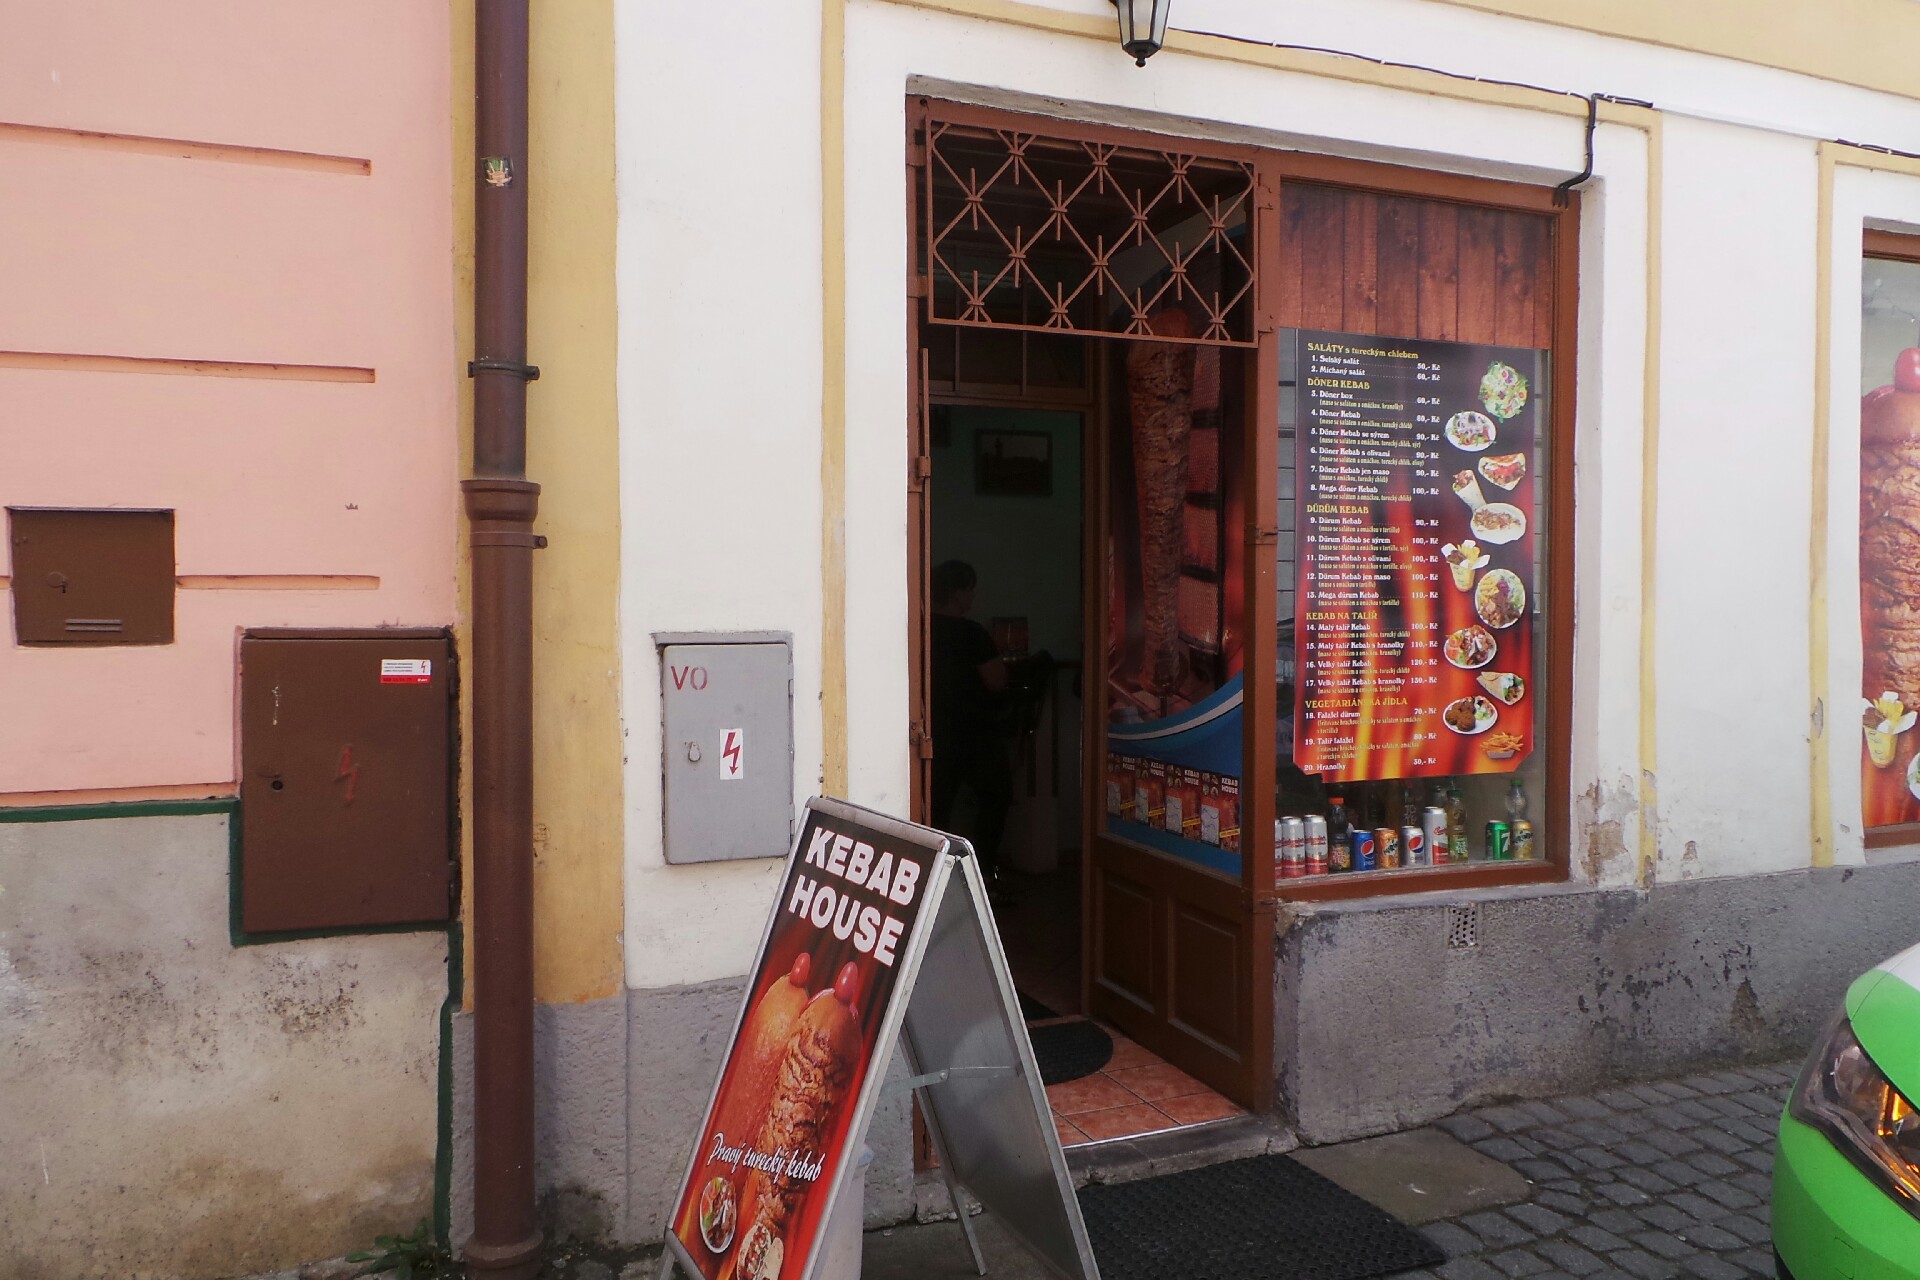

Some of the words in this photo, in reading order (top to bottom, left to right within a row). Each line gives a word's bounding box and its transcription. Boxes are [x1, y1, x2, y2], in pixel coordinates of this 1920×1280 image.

[1308, 342, 1344, 352] SALÁTY
[1352, 347, 1386, 358] tureckým
[1387, 349, 1419, 359] chlebem
[1343, 357, 1360, 365] salát
[1319, 366, 1347, 376] Míchaný
[1349, 368, 1365, 376] salát
[1307, 377, 1339, 387] DÖNER
[1340, 381, 1370, 390] KEBAB
[1319, 409, 1340, 417] Döner
[1319, 428, 1339, 436] Döner
[1319, 447, 1339, 455] Döner
[1340, 448, 1360, 456] Kebab
[1319, 485, 1337, 493] Mega
[1339, 506, 1369, 514] KEBAB
[1371, 537, 1391, 545] sýrem
[1352, 610, 1378, 619] TALÍŘ
[1318, 624, 1334, 632] Malý
[1377, 641, 1405, 649] hranolky
[670, 666, 707, 690] VO
[1318, 679, 1335, 687] Velký
[1382, 696, 1408, 705] JÍDLA
[1317, 763, 1346, 772] Hranolky
[1221, 777, 1238, 787] KEBAB
[1221, 785, 1238, 795] HOUSE
[804, 826, 920, 906] KEBAB
[788, 874, 904, 967] HOUSE
[706, 1132, 747, 1174] Pravý
[742, 1147, 790, 1184] turecký
[784, 1149, 826, 1182] kebab
